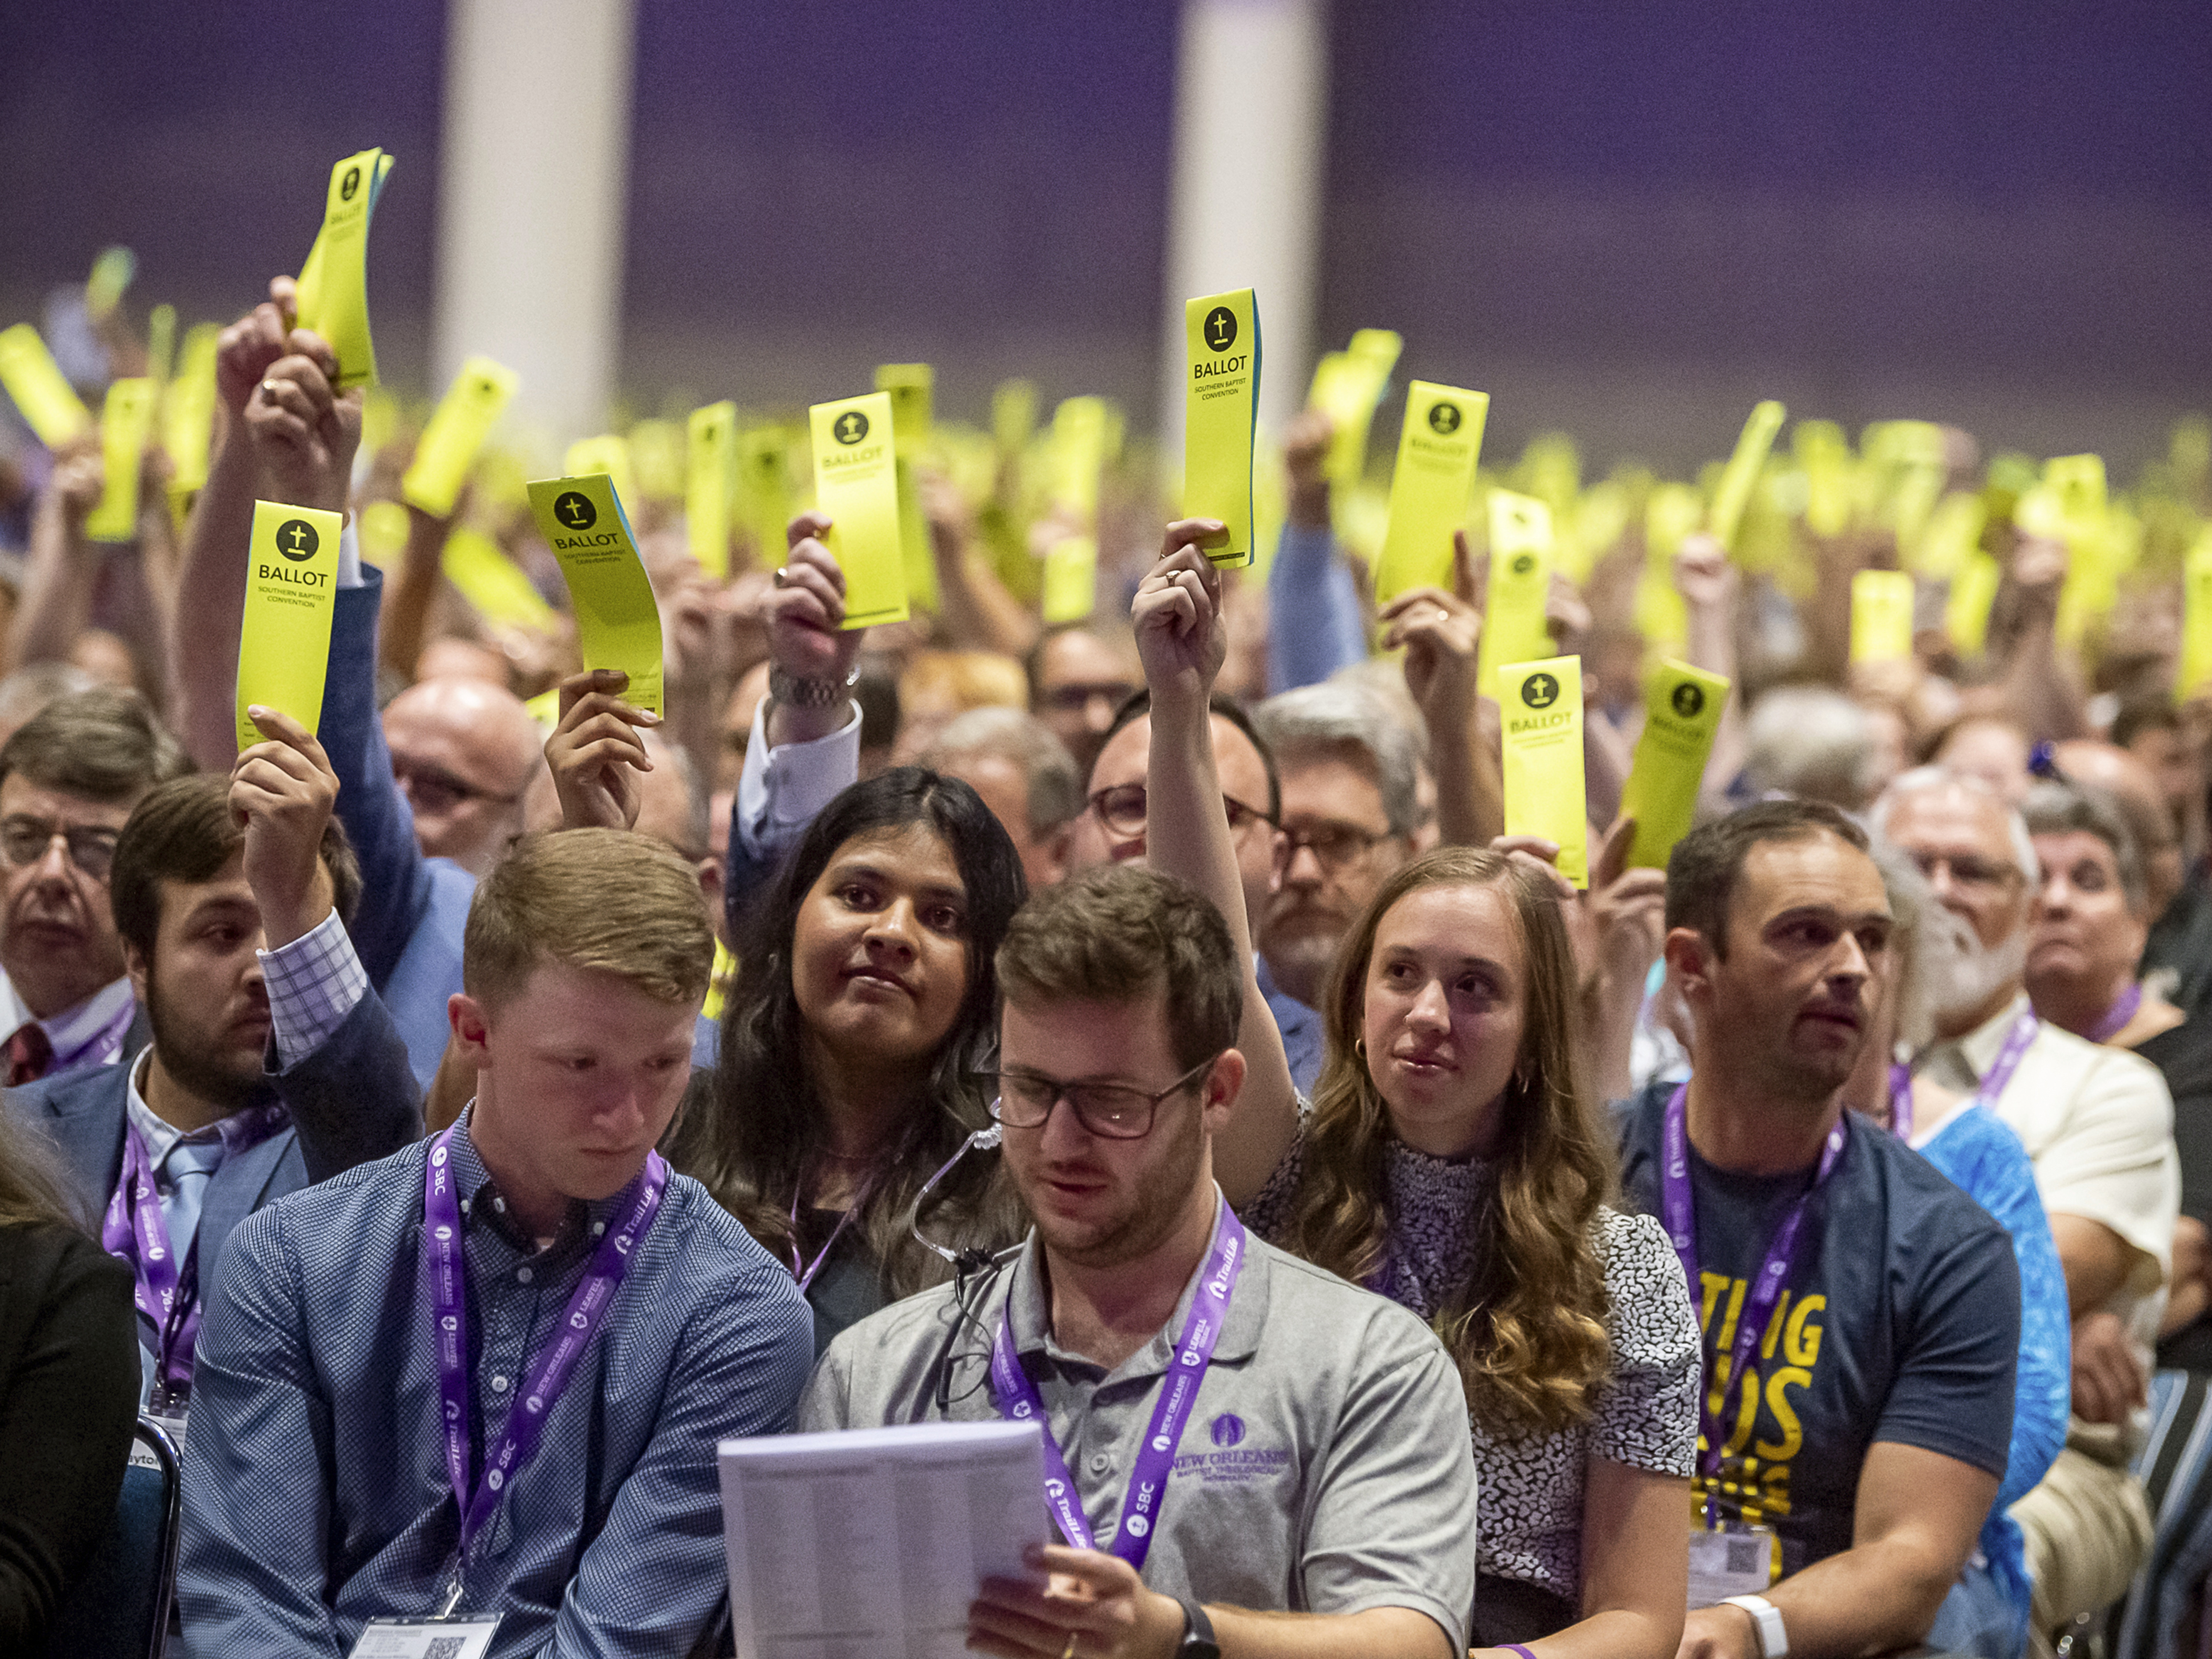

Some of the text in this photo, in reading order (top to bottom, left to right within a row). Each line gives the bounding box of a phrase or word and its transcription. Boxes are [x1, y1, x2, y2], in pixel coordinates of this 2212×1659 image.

[1194, 355, 1247, 379] BALLOT
[1194, 378, 1246, 393] SOUTHERN BAPTIST
[1202, 388, 1239, 400] CONVENTION
[555, 533, 617, 550] BALLOT
[259, 565, 328, 587] BALLOT
[258, 586, 325, 601] SOUTHERN BAPTIST
[267, 596, 315, 608] CONVENTION
[1510, 711, 1571, 734] BALLOT
[434, 1167, 446, 1197] SBC
[442, 1242, 453, 1306] NEW ORLEANS
[536, 1373, 551, 1395] NEW
[547, 1336, 573, 1375] ORLEANS
[1160, 1414, 1173, 1434] NEW
[1167, 1374, 1188, 1414] ORLEANS
[129, 1454, 159, 1466] ayto
[499, 1439, 516, 1469] SBC
[1136, 1482, 1155, 1513] SBC
